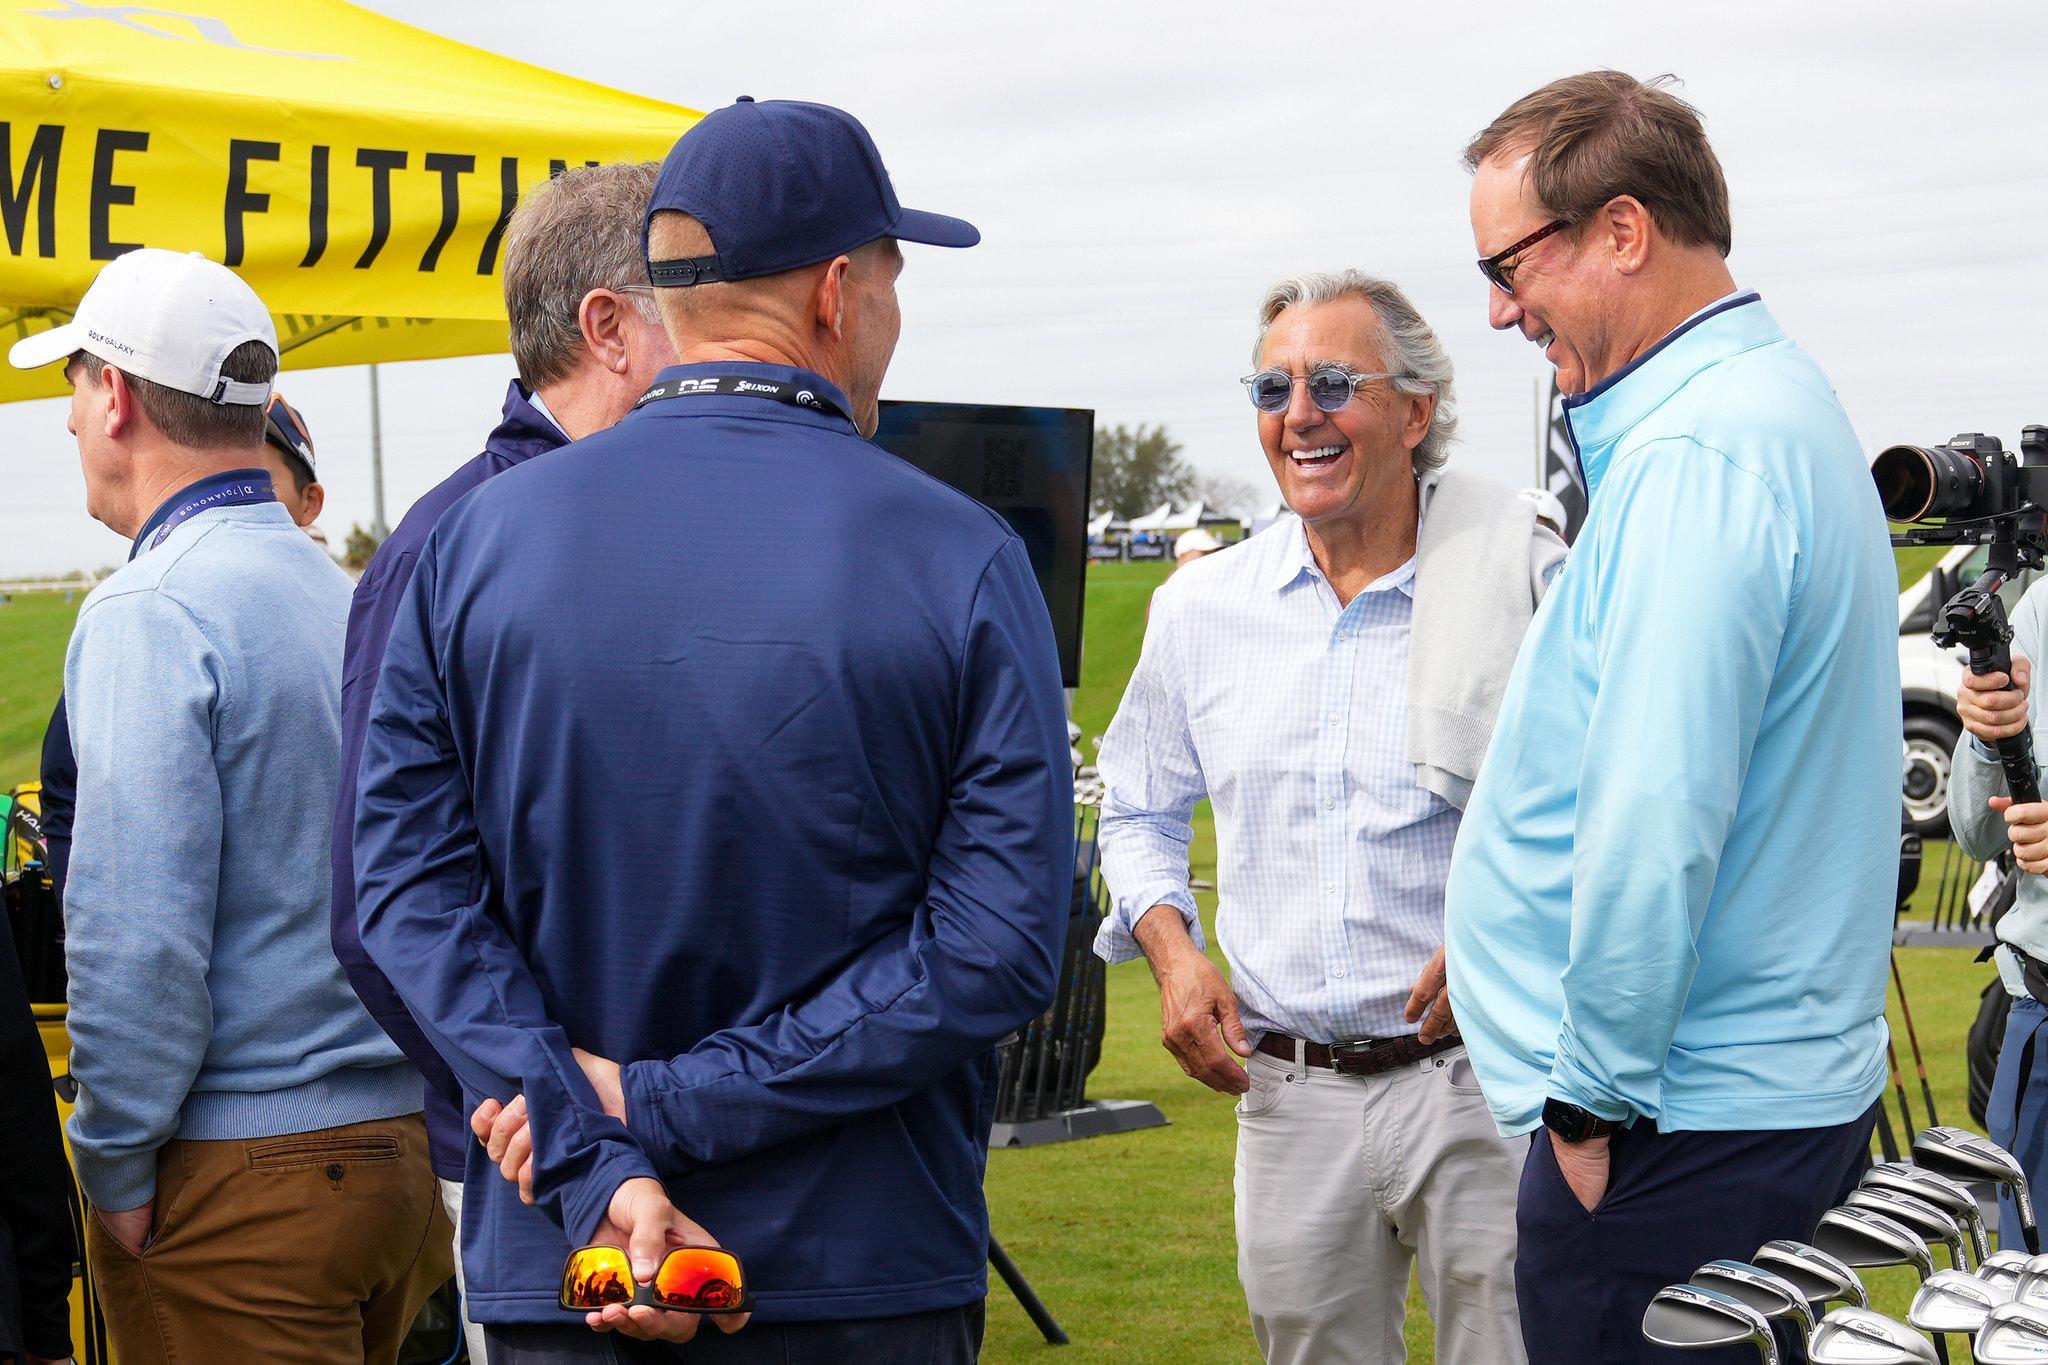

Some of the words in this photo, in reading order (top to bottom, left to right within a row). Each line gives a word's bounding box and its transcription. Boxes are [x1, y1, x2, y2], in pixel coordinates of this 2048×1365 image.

[223, 139, 600, 276] FITTI
[88, 330, 105, 342] GOLF
[104, 337, 135, 356] GALAXY
[733, 380, 780, 394] SRIXON
[1953, 1286, 1981, 1300] Cleveland
[1855, 1322, 1884, 1338] Cleveland
[2019, 1319, 2048, 1334] Cleveland
